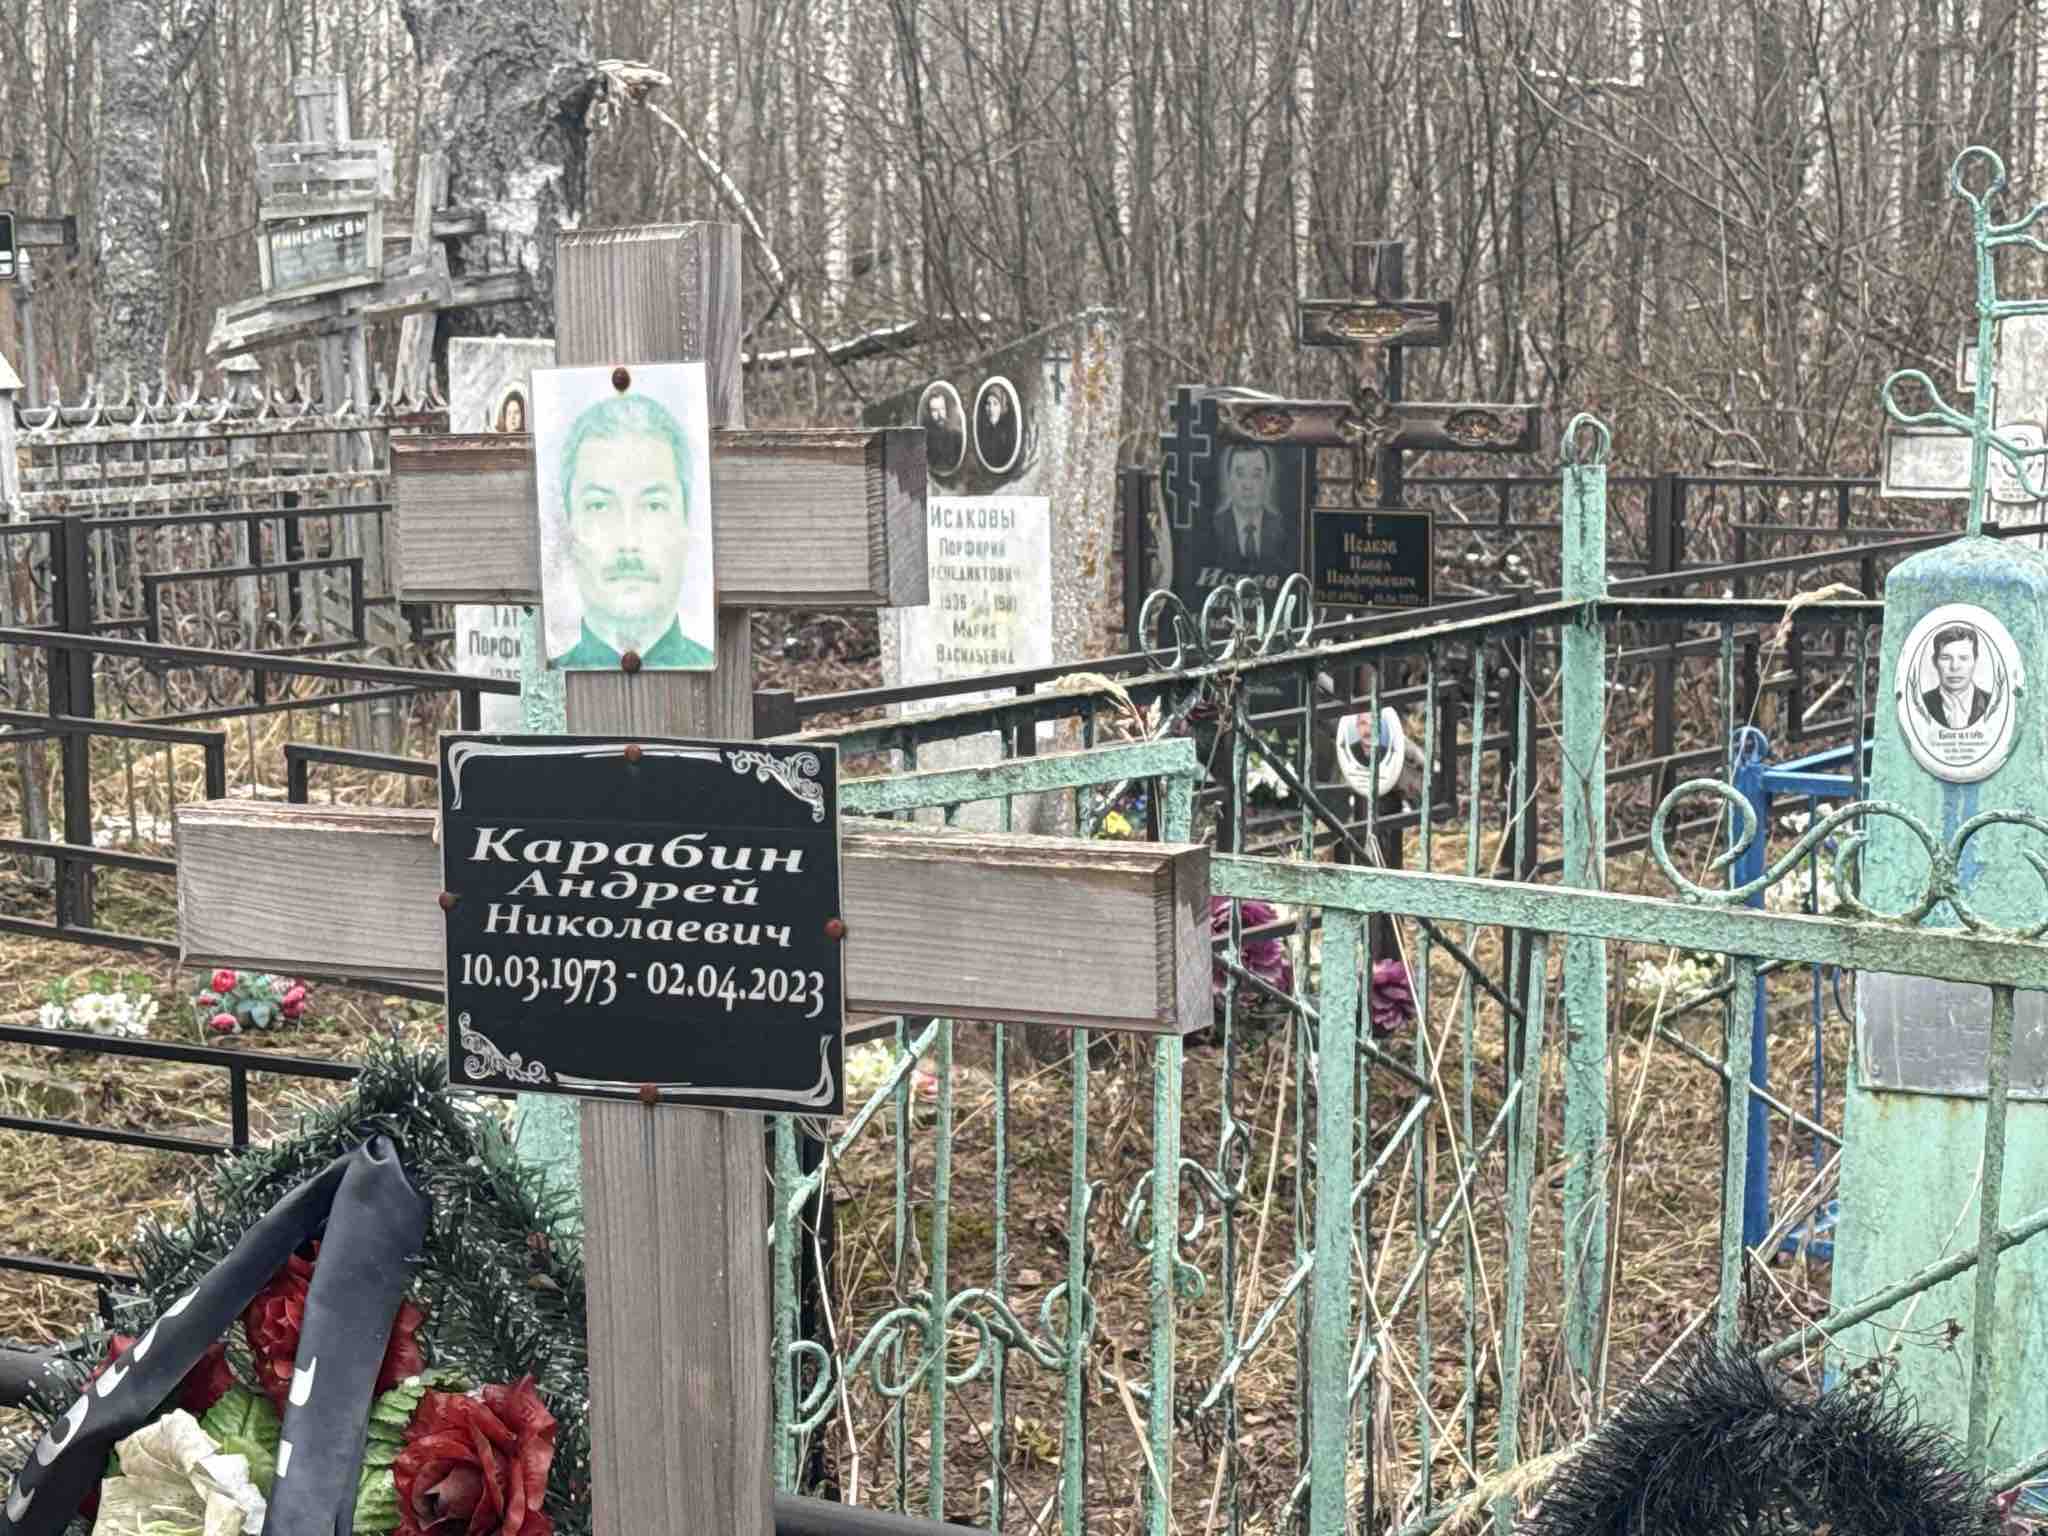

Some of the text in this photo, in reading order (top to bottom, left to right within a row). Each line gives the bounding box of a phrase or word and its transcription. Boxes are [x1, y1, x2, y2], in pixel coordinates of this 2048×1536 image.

[469, 827, 804, 875] Карабин
[506, 869, 761, 910] Андрей
[483, 904, 793, 948] Николаевич
[460, 954, 618, 1005] 10.03.1973
[647, 961, 825, 1019] 02.04.2023
